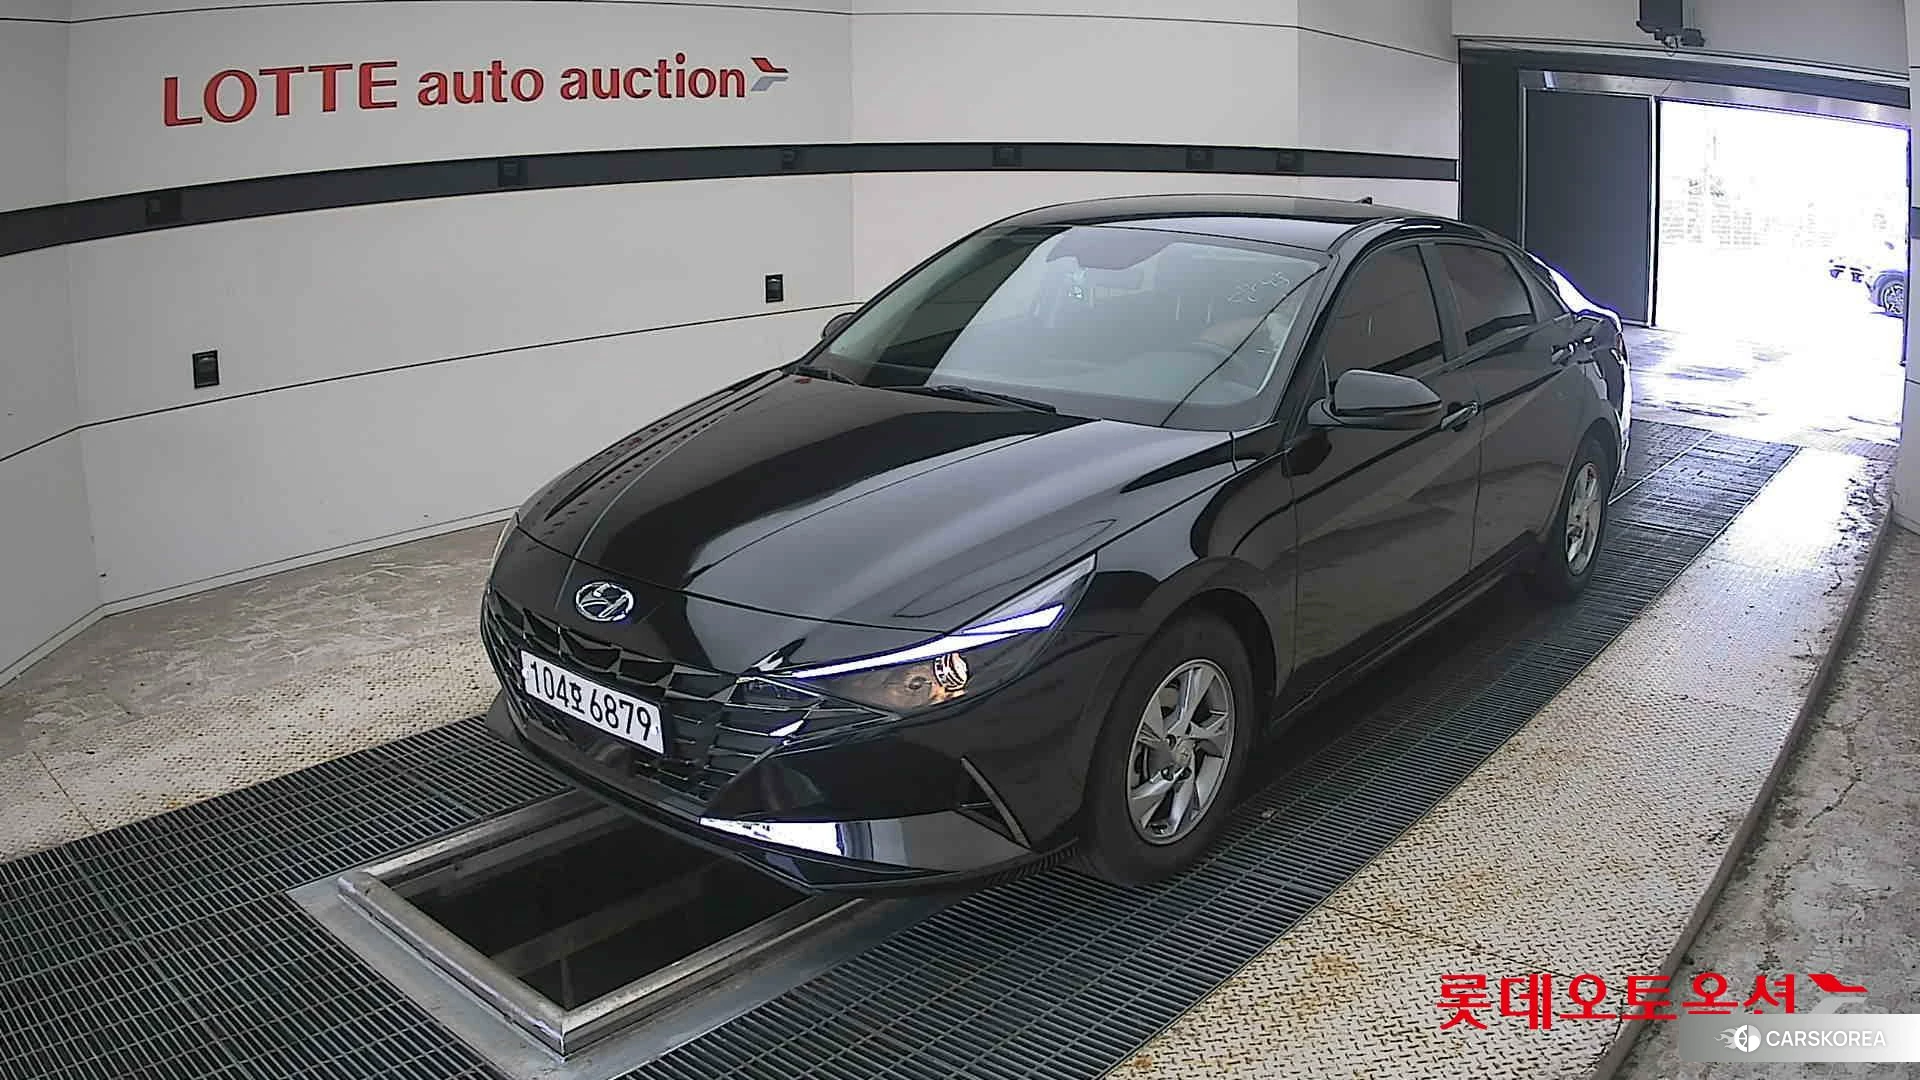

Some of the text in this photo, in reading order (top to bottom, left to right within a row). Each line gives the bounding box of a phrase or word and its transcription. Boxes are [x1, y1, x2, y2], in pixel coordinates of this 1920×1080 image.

[163, 53, 746, 126] LOTTE auto auction
[589, 688, 652, 742] 6879
